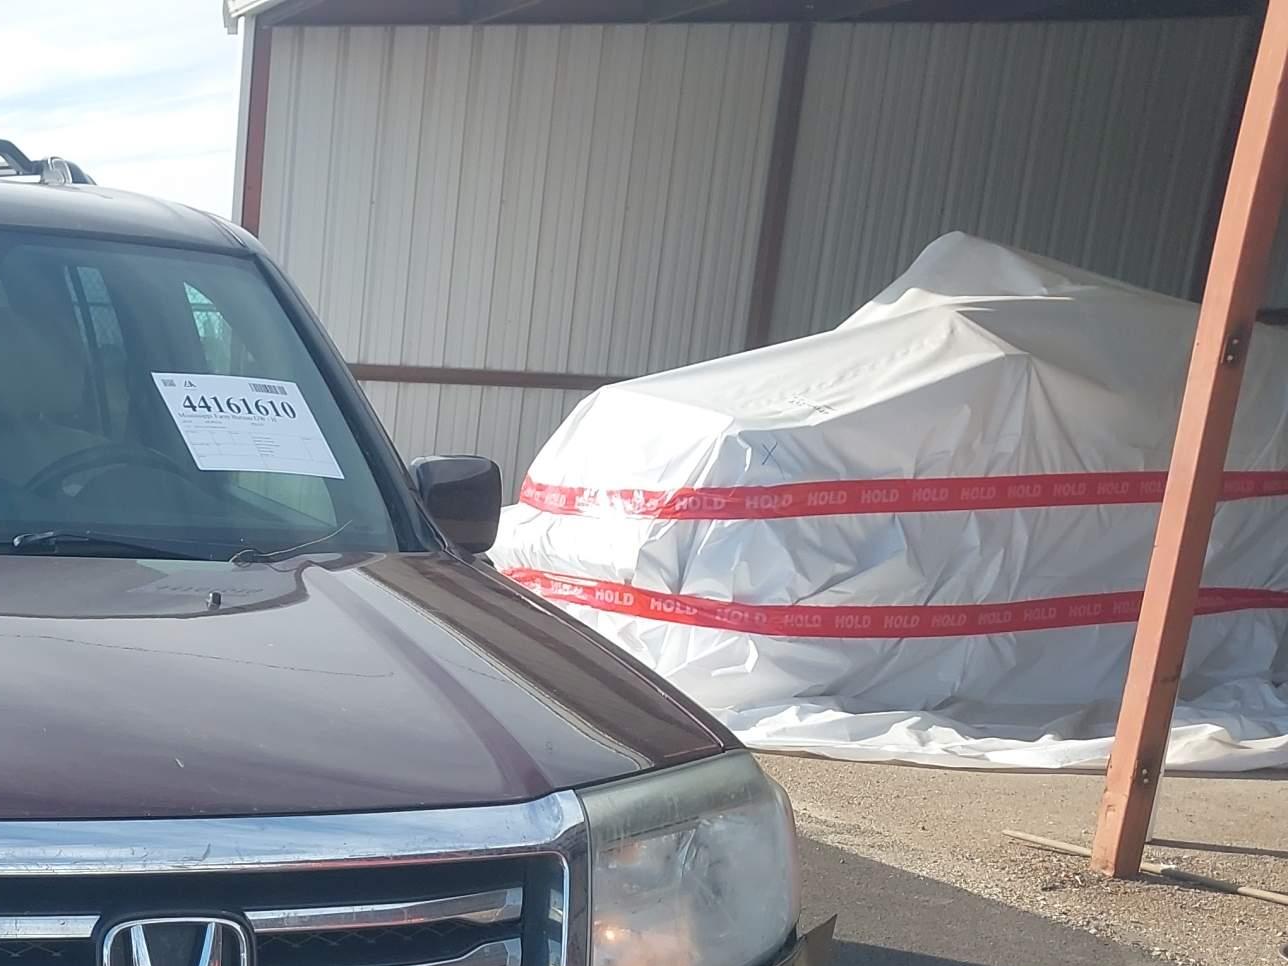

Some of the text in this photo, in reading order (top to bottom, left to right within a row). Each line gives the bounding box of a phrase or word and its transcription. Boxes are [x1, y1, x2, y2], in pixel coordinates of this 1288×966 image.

[182, 395, 297, 419] 44161610
[745, 494, 793, 510] HOLD
[807, 490, 848, 506] HOLD
[861, 488, 900, 504] HOLD
[912, 487, 949, 502] HOLD
[960, 486, 997, 500] HOLD
[1007, 484, 1043, 498] HOLD
[1053, 482, 1087, 496] HOLD
[1097, 480, 1130, 495] HOLD
[1140, 480, 1166, 495] HOL
[595, 589, 635, 606] HOLD
[650, 597, 698, 616] HOLD
[715, 607, 768, 626] HOLD
[784, 614, 822, 628] HOLD
[835, 614, 872, 629] HOLD
[883, 614, 921, 629] HOLD
[932, 613, 968, 628] HOLD
[978, 611, 1012, 625] HOLD
[1023, 607, 1057, 621] HOLD
[1069, 603, 1102, 617] HOLD
